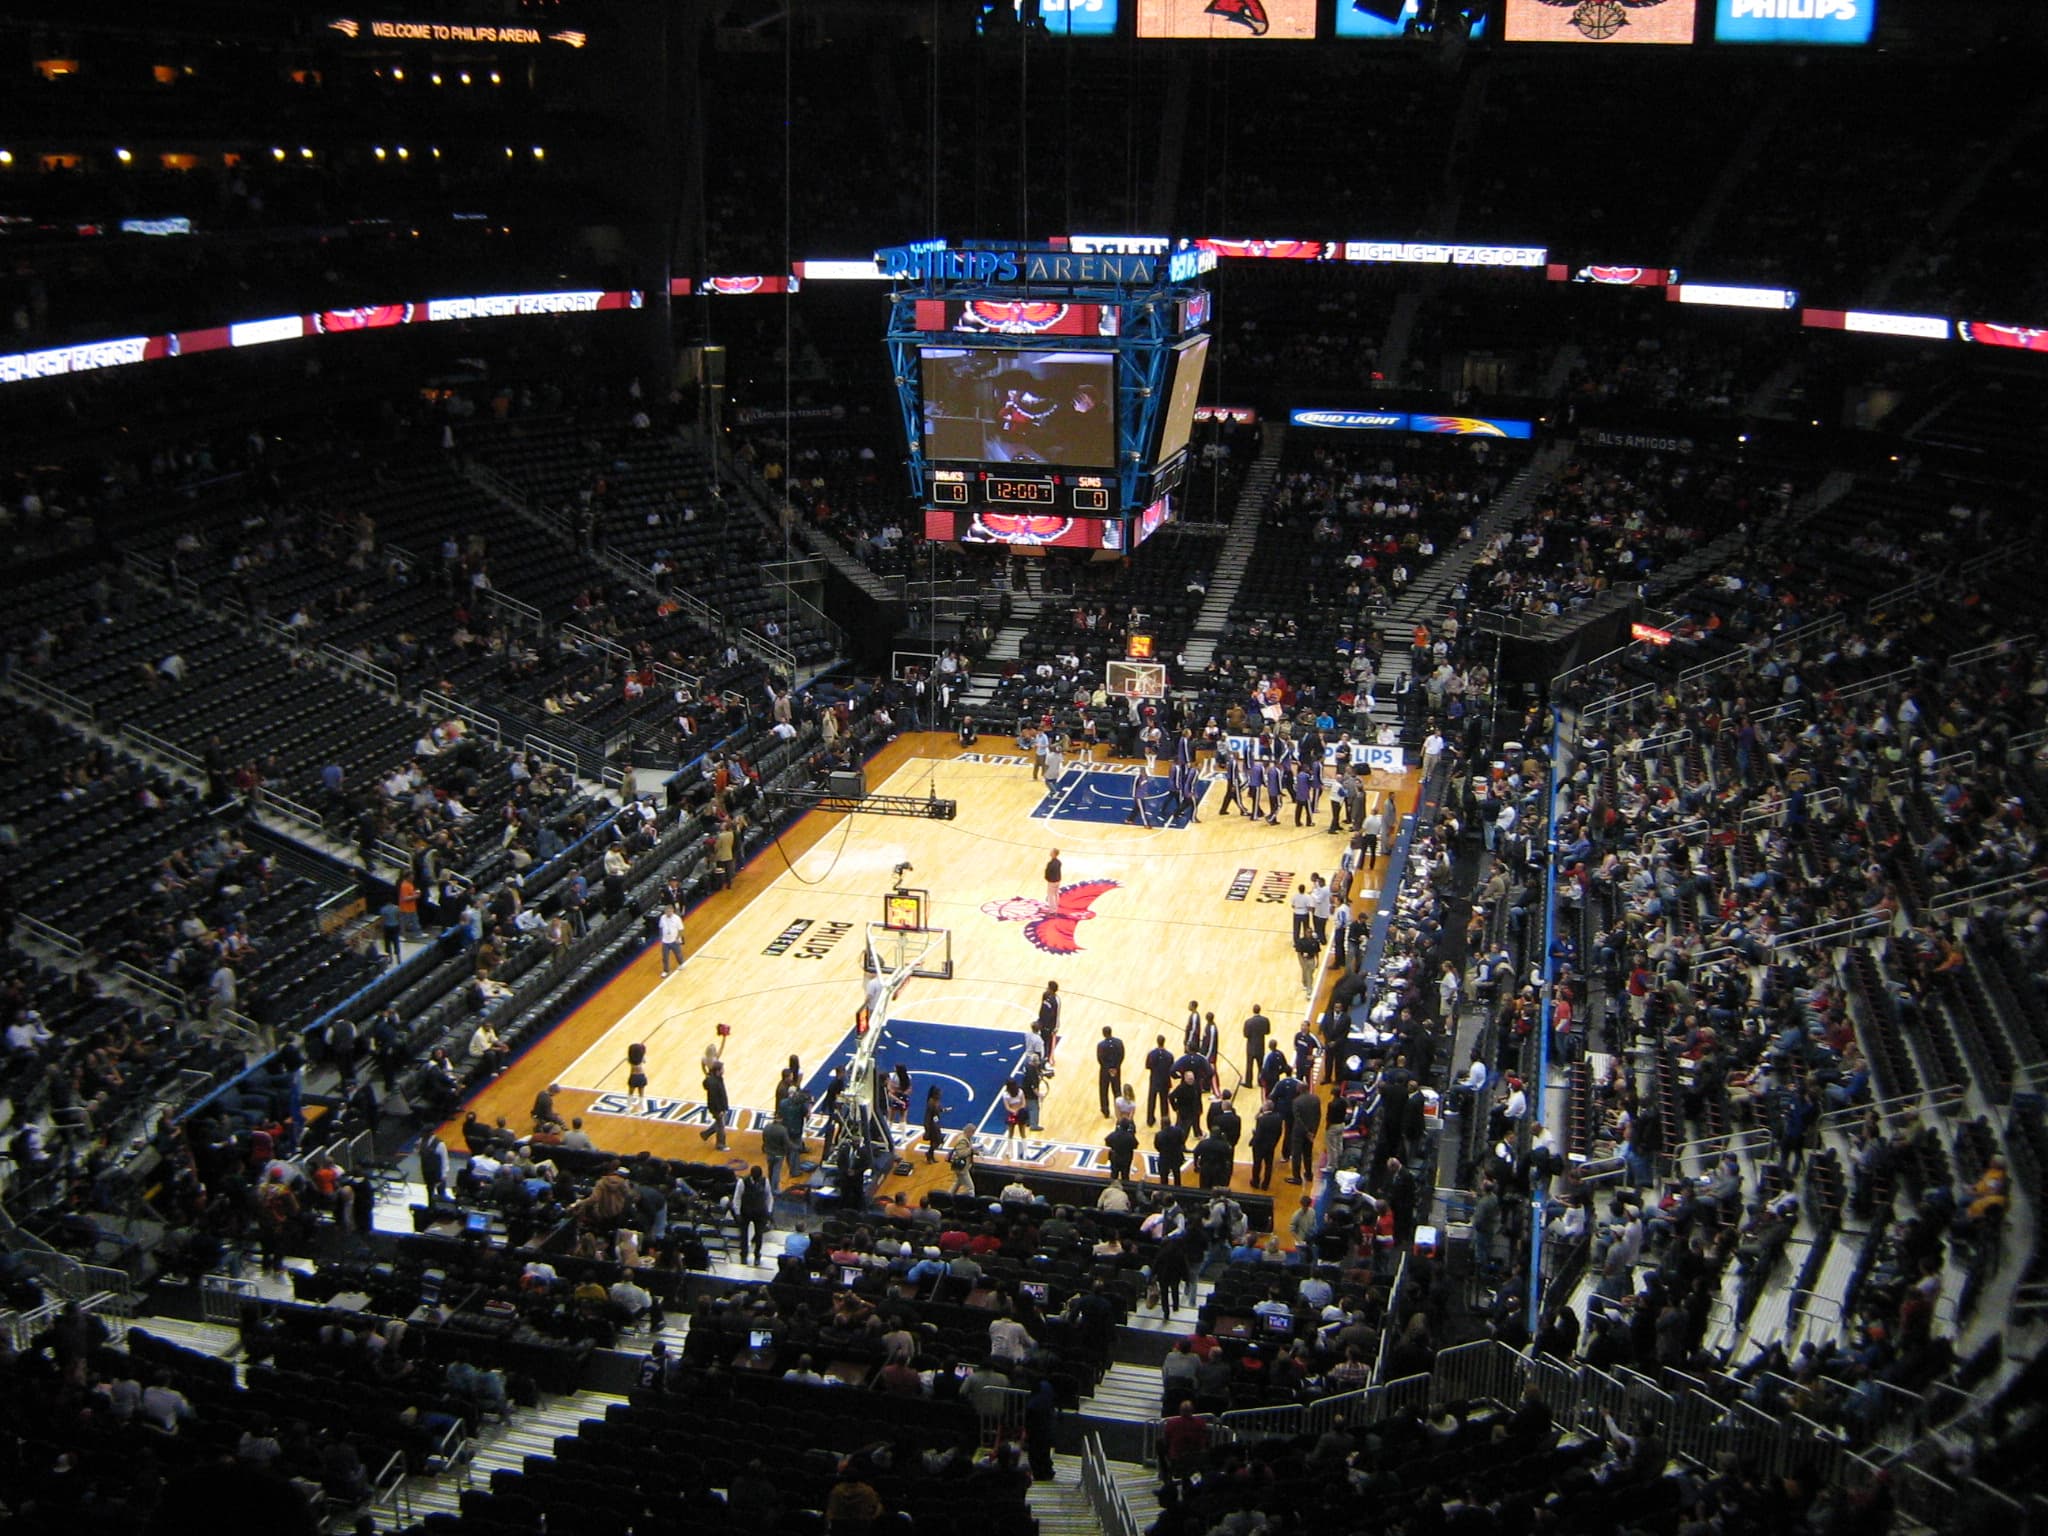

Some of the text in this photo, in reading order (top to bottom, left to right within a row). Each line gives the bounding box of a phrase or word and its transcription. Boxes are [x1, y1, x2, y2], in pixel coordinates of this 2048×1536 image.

[1731, 0, 1857, 20] PHILIPS
[371, 21, 541, 44] WELCOME TO PHILIPS ARENA
[1347, 243, 1542, 266] HIGHLIGHT FACTORY
[886, 250, 1018, 281] PHILIPS
[1029, 256, 1154, 282] ARENA
[519, 292, 600, 314] FACTORY
[1306, 414, 1400, 426] BUD LIGHT
[1625, 434, 1676, 451] AMIGOS
[953, 485, 963, 500] 0
[997, 483, 1037, 500] 12:00
[1078, 476, 1102, 488] SUNS
[1093, 491, 1104, 507] 0
[952, 752, 1150, 776] ATLNTA
[1255, 870, 1295, 904] PHILIPS
[794, 920, 854, 960] PHILIPS
[887, 1122, 1194, 1180] ALANTA
